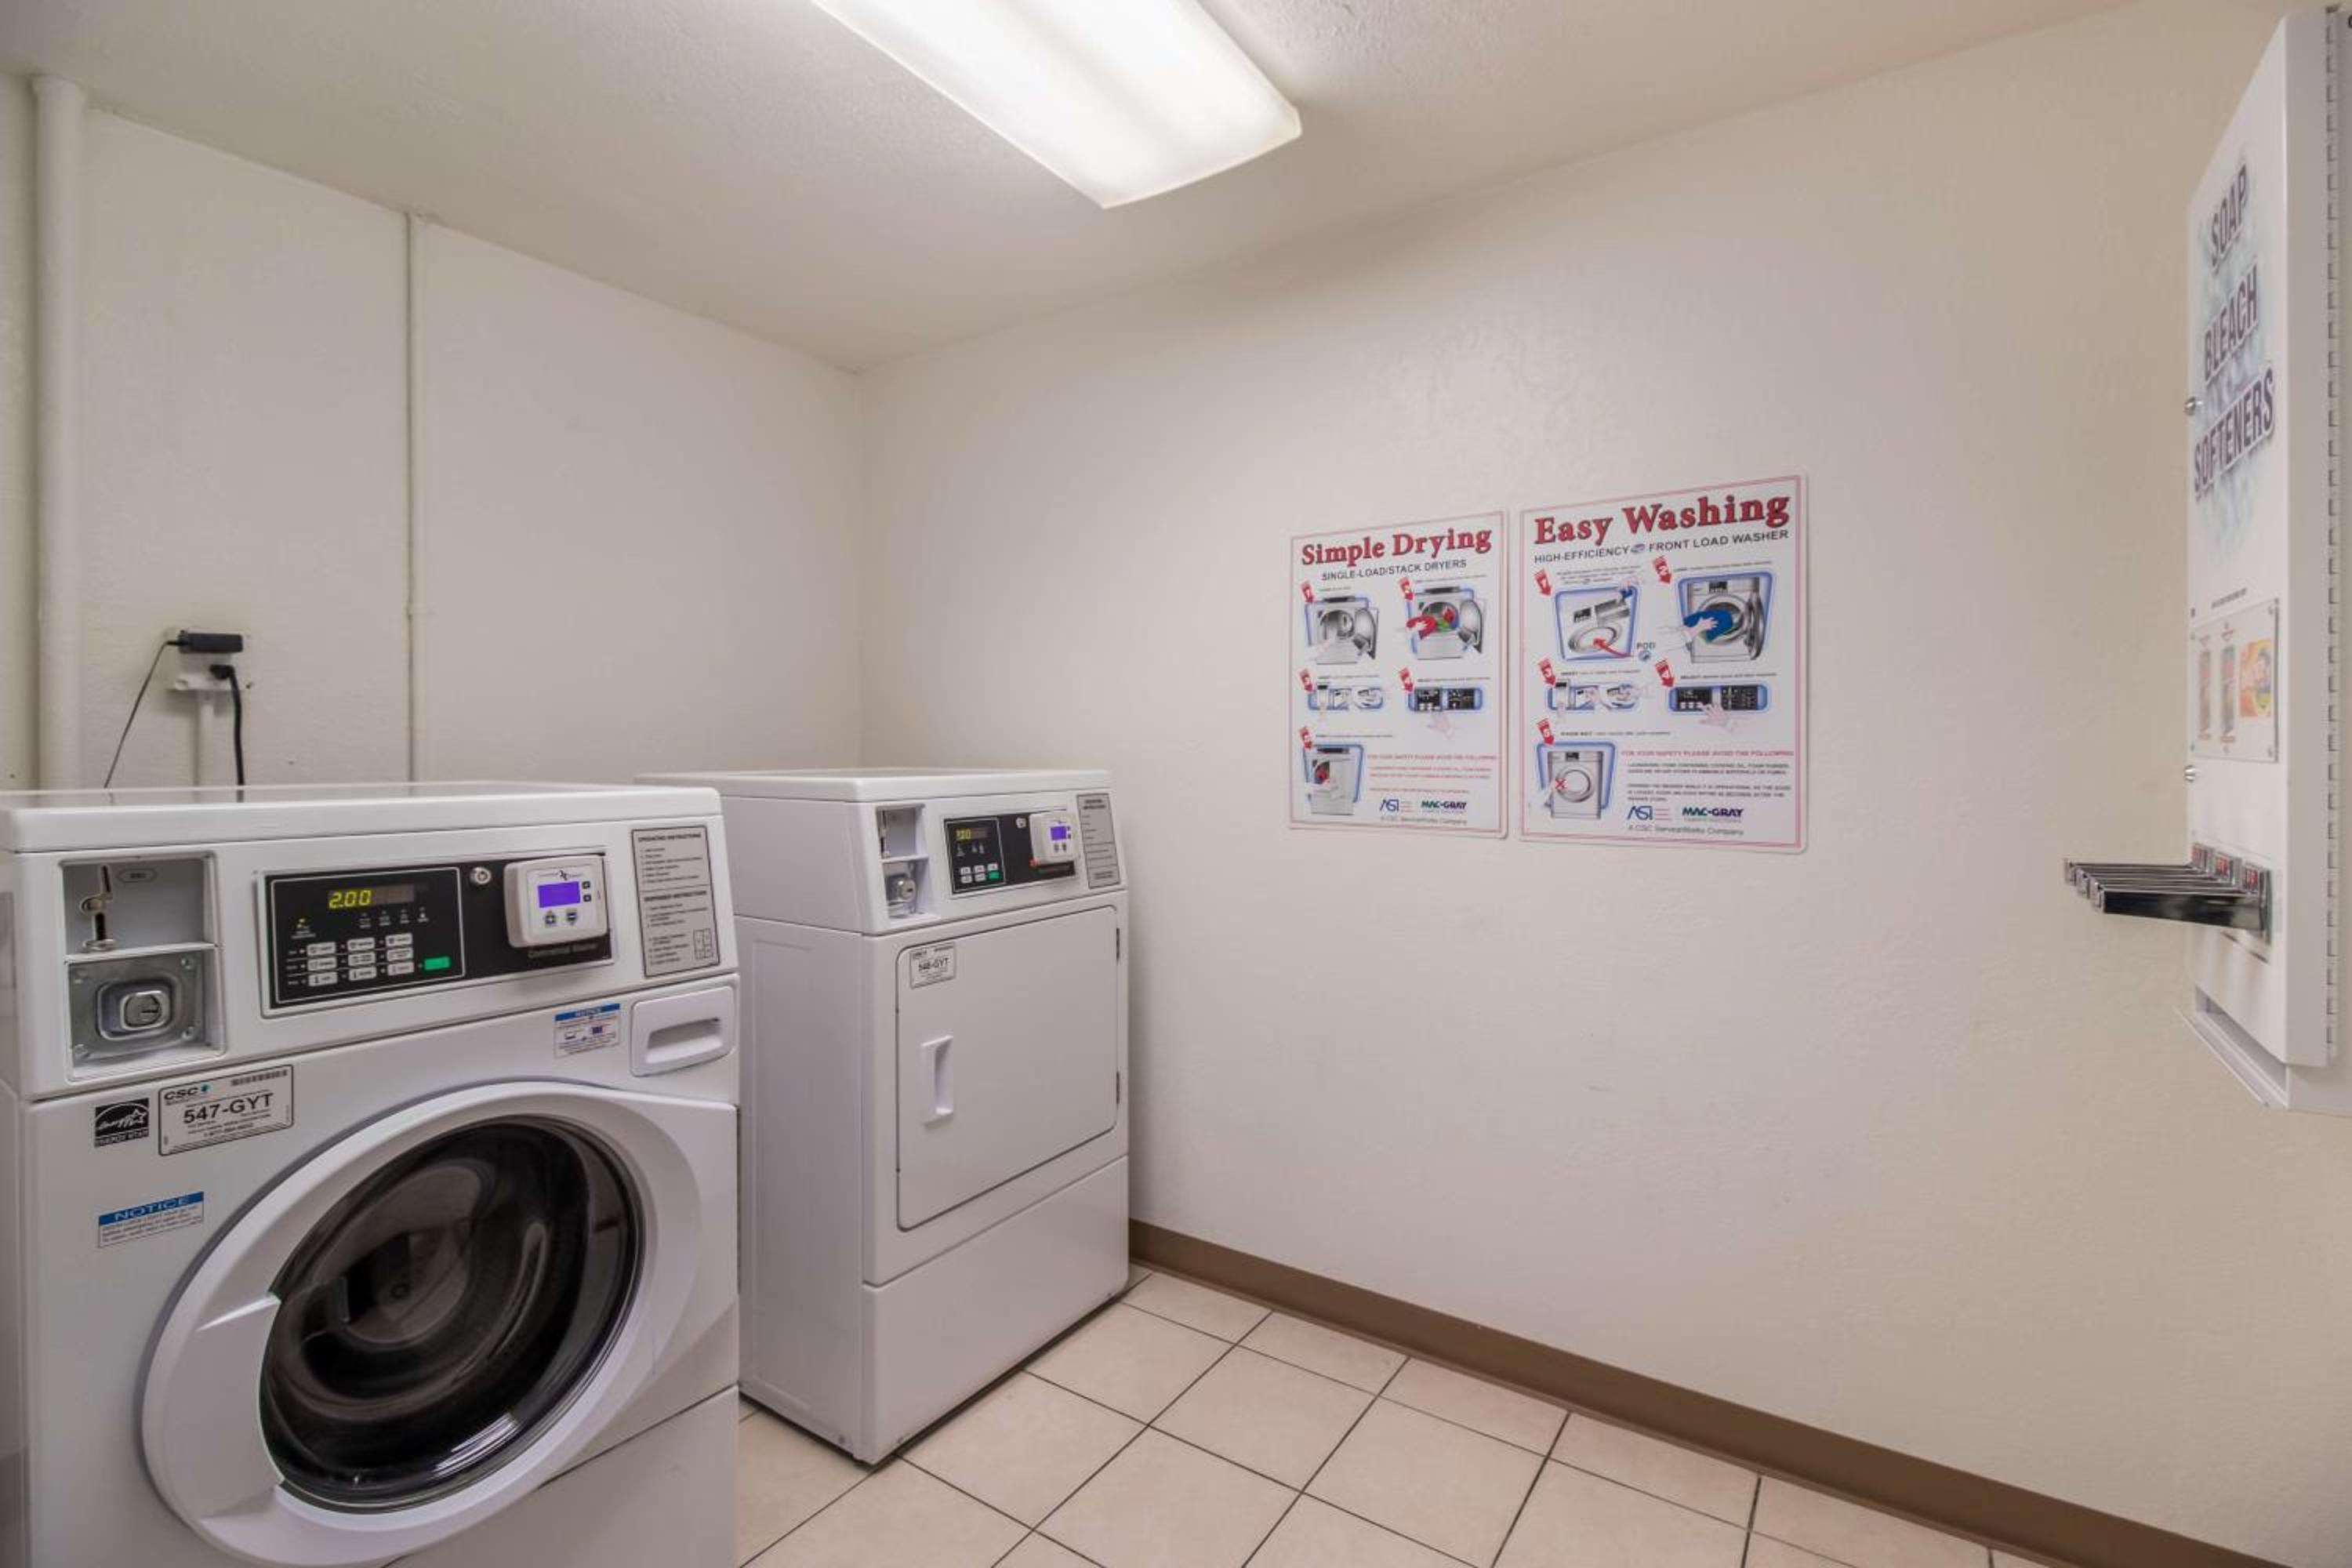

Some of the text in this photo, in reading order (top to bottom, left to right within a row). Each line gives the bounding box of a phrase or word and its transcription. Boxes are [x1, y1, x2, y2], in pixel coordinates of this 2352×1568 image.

[2211, 165, 2247, 268] SOAP
[2205, 263, 2257, 383] BLEACH
[2195, 367, 2273, 492] SOFTENERS
[1534, 495, 1791, 546] Easy Washing
[1301, 528, 1492, 567] Simple Drying
[1534, 530, 1789, 564] HIGH-EFFICIENCY FRONT LOAD WASHER
[1425, 559, 1467, 572] DRYERS
[1421, 800, 1467, 810] MAC-GRAY
[1682, 806, 1744, 817] MAC-GRAY
[328, 890, 372, 909] 2.00
[164, 1087, 199, 1101] CSC
[183, 1092, 274, 1124] 547-GYT
[114, 1197, 190, 1221] NOTICE
